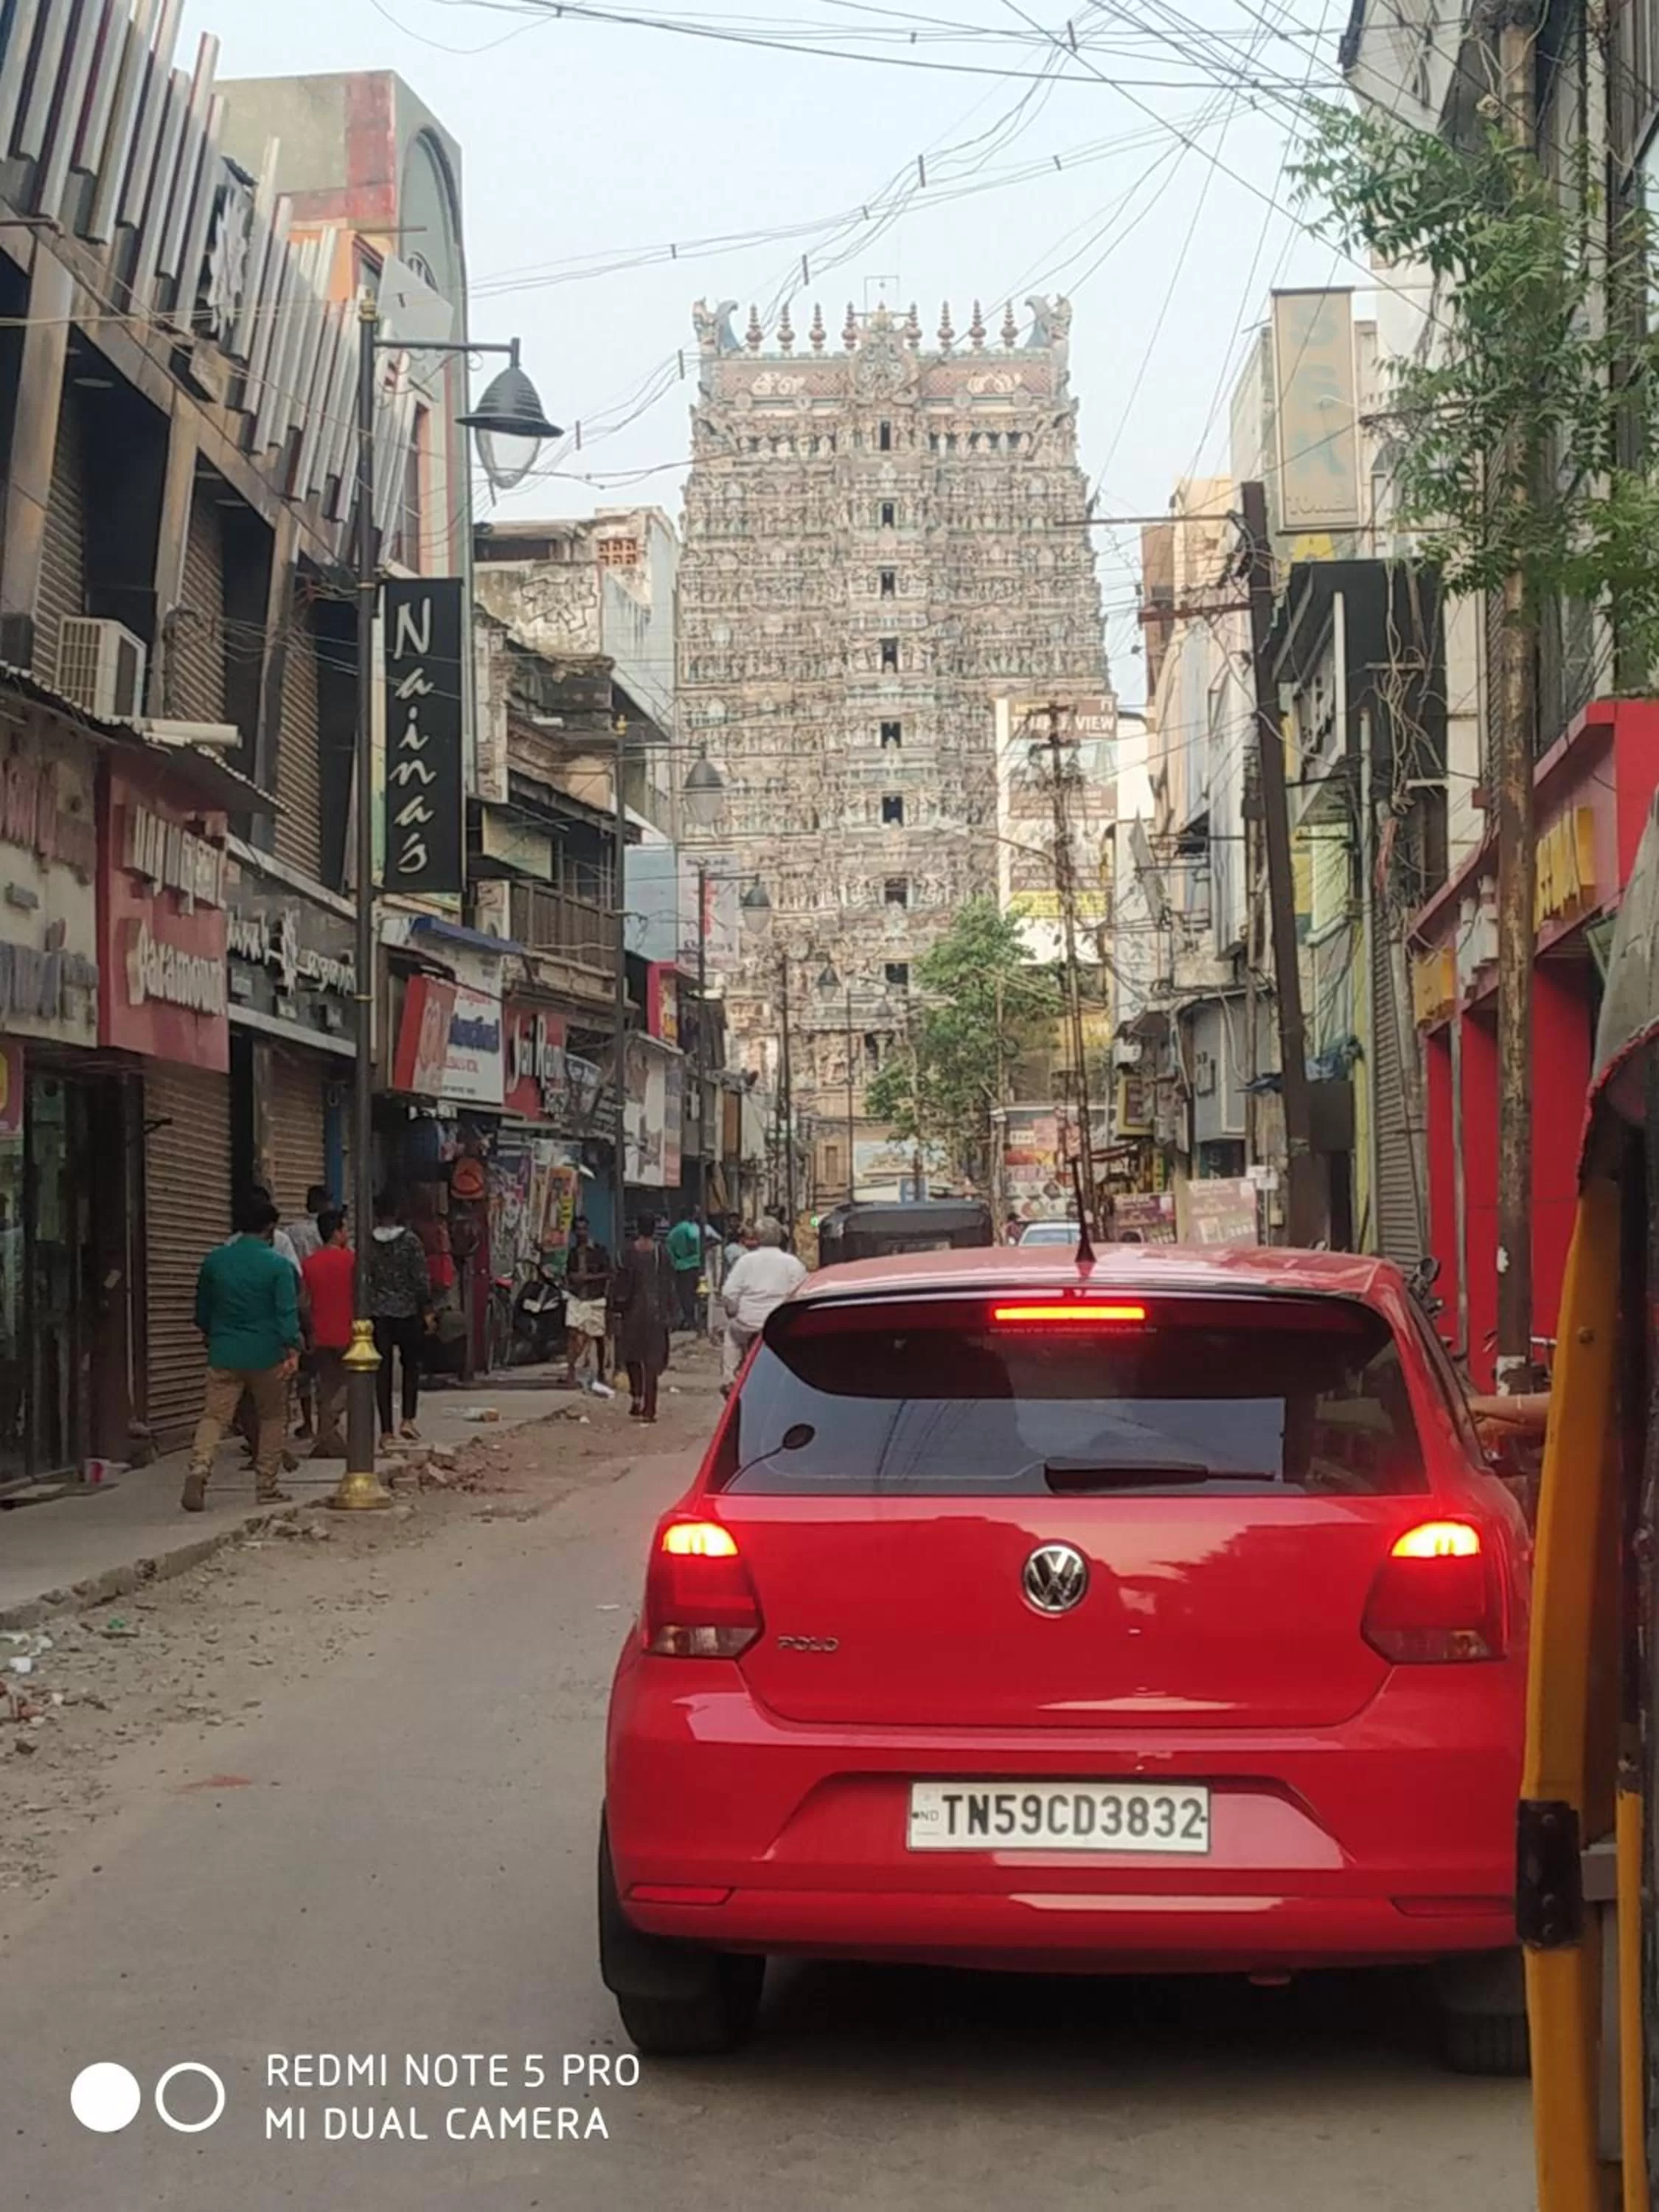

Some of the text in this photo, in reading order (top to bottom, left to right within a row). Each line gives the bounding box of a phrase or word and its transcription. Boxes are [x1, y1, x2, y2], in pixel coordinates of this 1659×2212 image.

[1074, 714, 1114, 731] VIEW
[778, 1635, 839, 1652] POLO
[942, 1794, 1203, 1839] TN59CD3832
